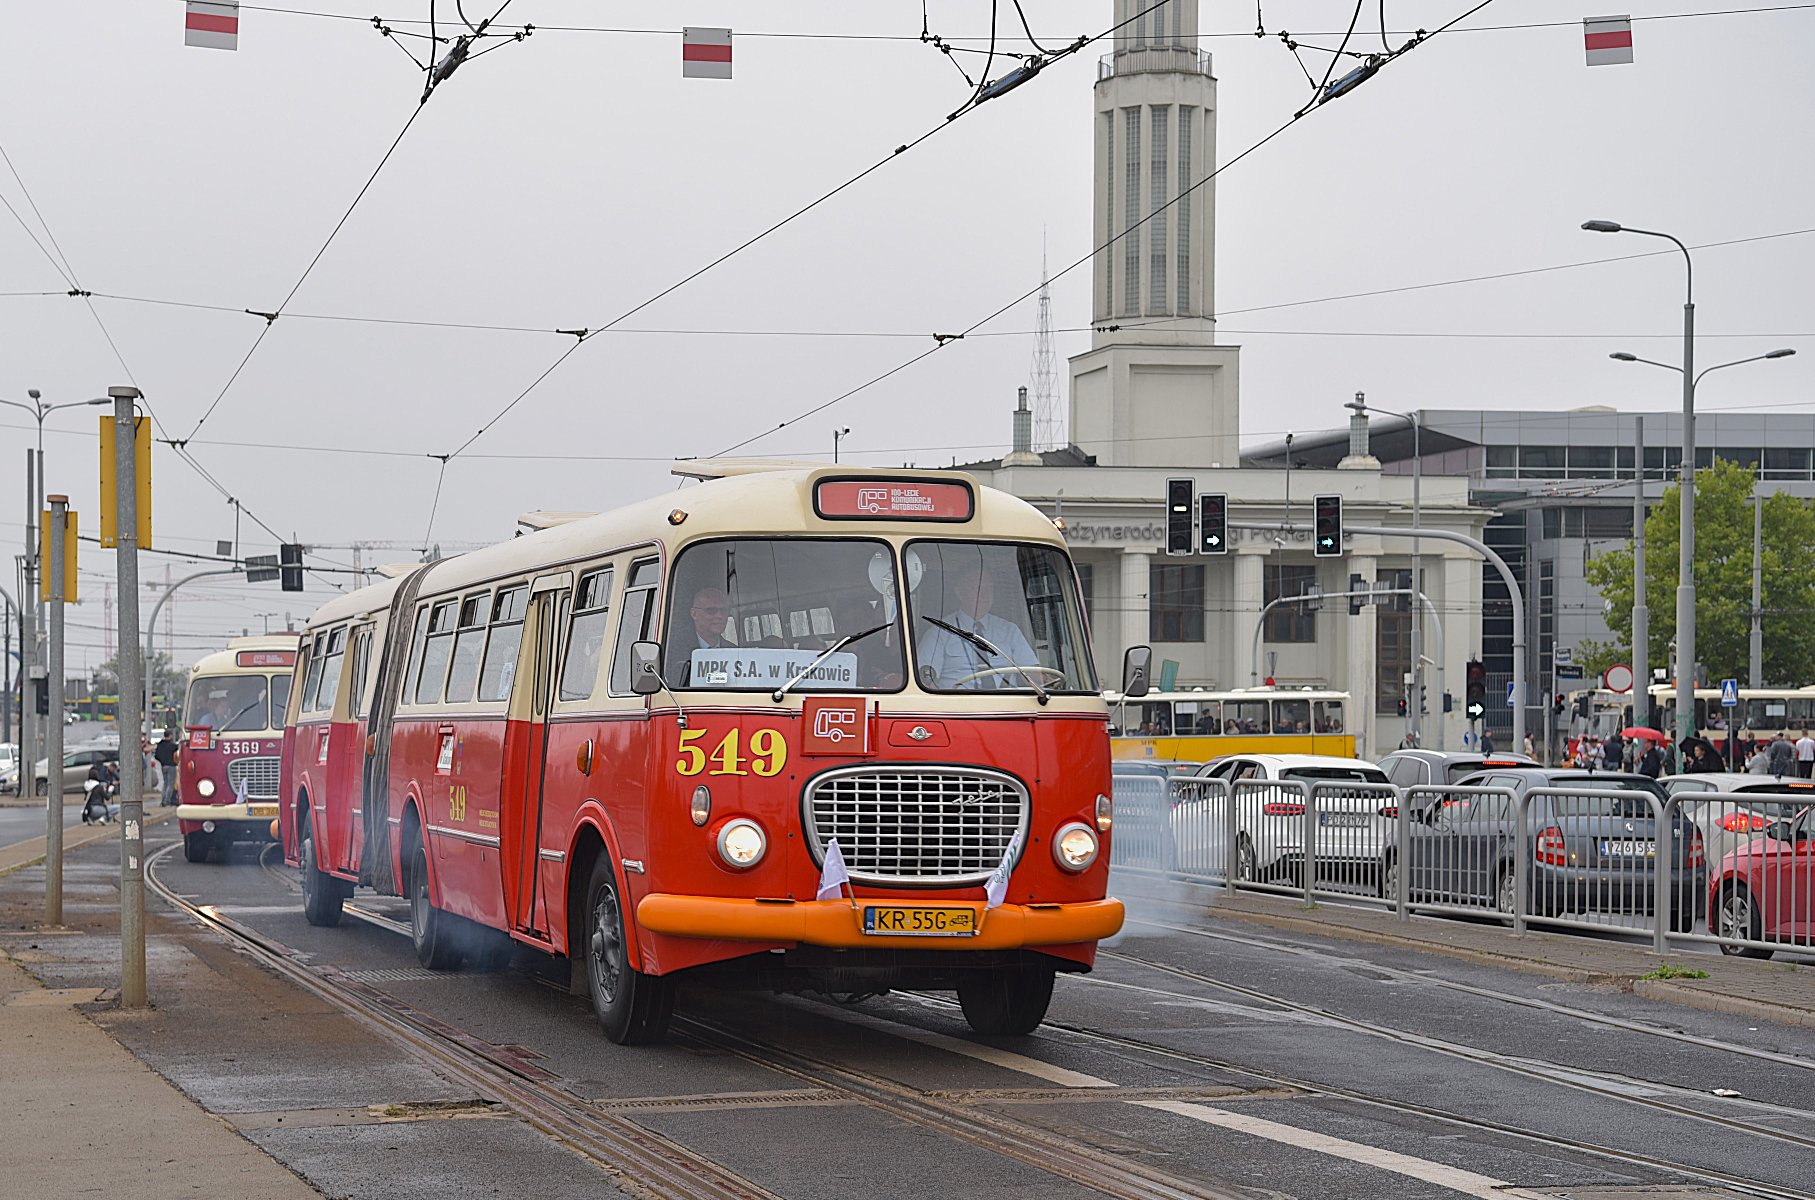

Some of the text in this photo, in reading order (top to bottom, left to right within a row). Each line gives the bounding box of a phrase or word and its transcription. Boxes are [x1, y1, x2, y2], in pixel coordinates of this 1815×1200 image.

[697, 660, 729, 678] MPK
[733, 660, 762, 678] S.A.
[769, 665, 780, 678] w
[785, 661, 851, 682] Krakowie
[222, 741, 260, 755] 3369
[675, 727, 788, 777] 549
[449, 785, 466, 822] 549
[878, 910, 947, 930] KR 55G
